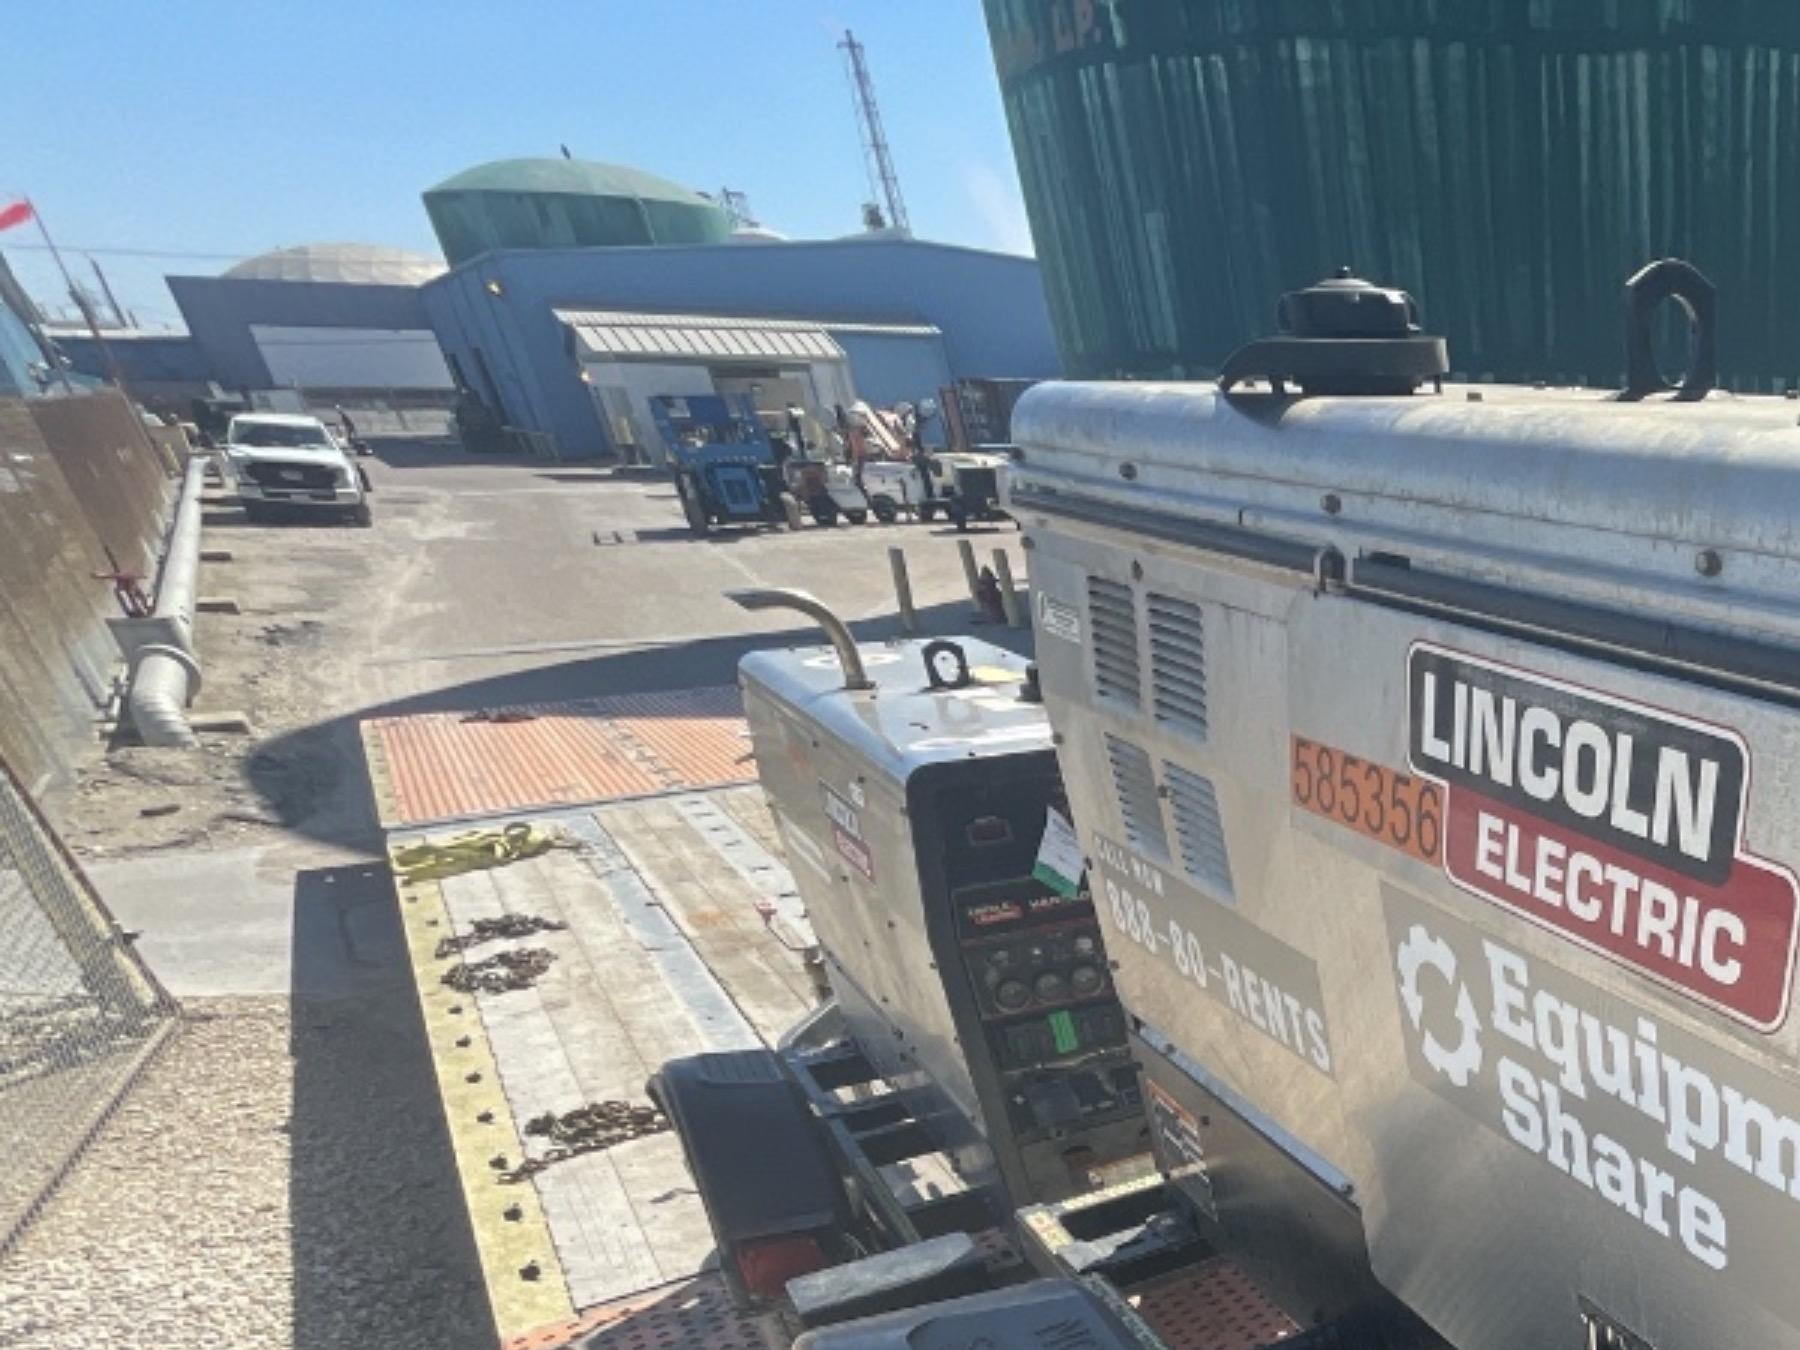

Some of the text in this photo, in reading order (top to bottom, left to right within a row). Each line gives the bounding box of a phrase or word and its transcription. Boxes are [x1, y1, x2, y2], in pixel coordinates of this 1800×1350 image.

[1294, 739, 1440, 859] 585356
[1421, 671, 1719, 862] LINCOLN
[1475, 811, 1747, 986] ELECTRIC
